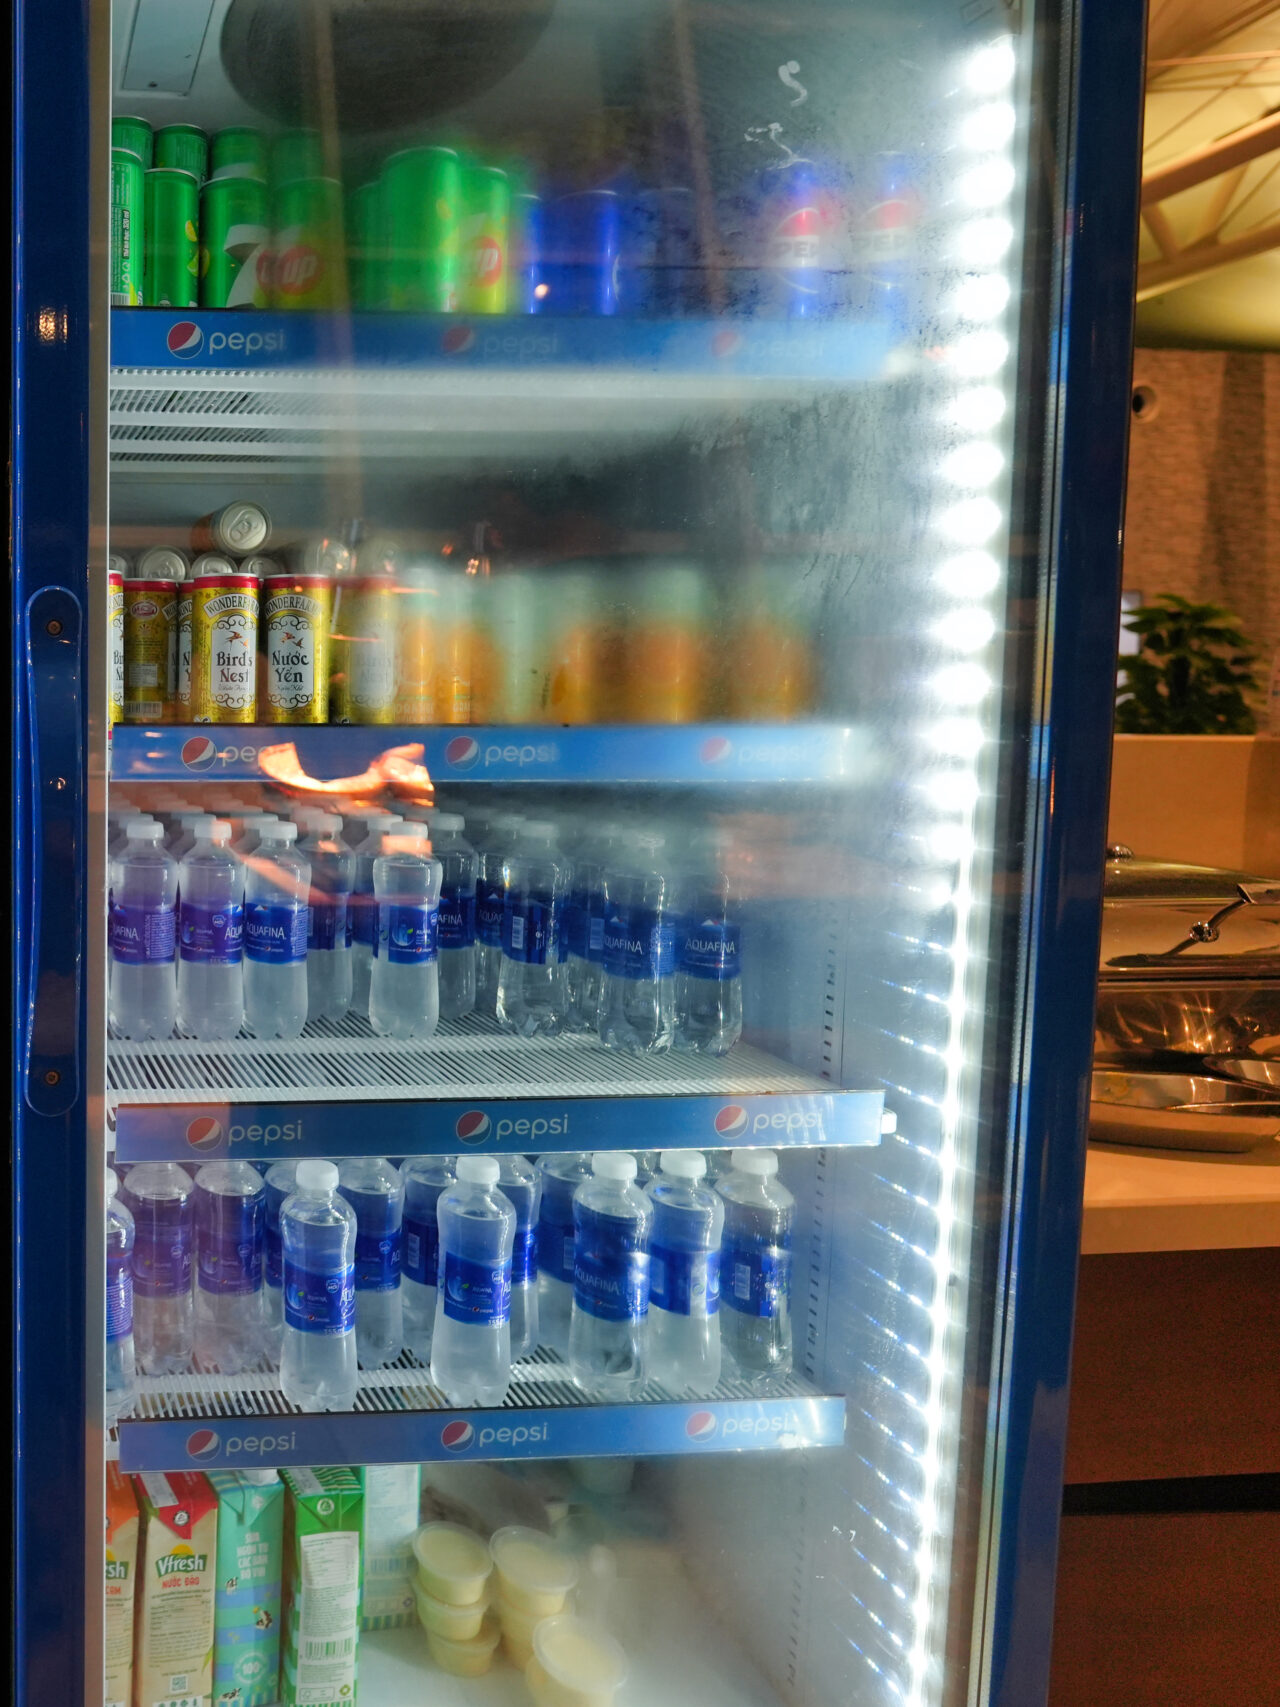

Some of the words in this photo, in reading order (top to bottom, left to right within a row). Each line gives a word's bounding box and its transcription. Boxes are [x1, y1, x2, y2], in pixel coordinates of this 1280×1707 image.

[209, 328, 285, 355] pepsi
[272, 651, 309, 666] Nước
[220, 669, 250, 683] Nest
[275, 666, 304, 683] Yến
[485, 743, 558, 768] pepsi
[228, 1119, 303, 1147] pepsi
[496, 1113, 569, 1141] pepsi
[753, 1109, 822, 1135] pepsi
[479, 1422, 550, 1447] pepsi
[722, 1413, 791, 1437] pepsi
[226, 1431, 296, 1457] pepsi
[158, 1555, 204, 1576] Vfresh
